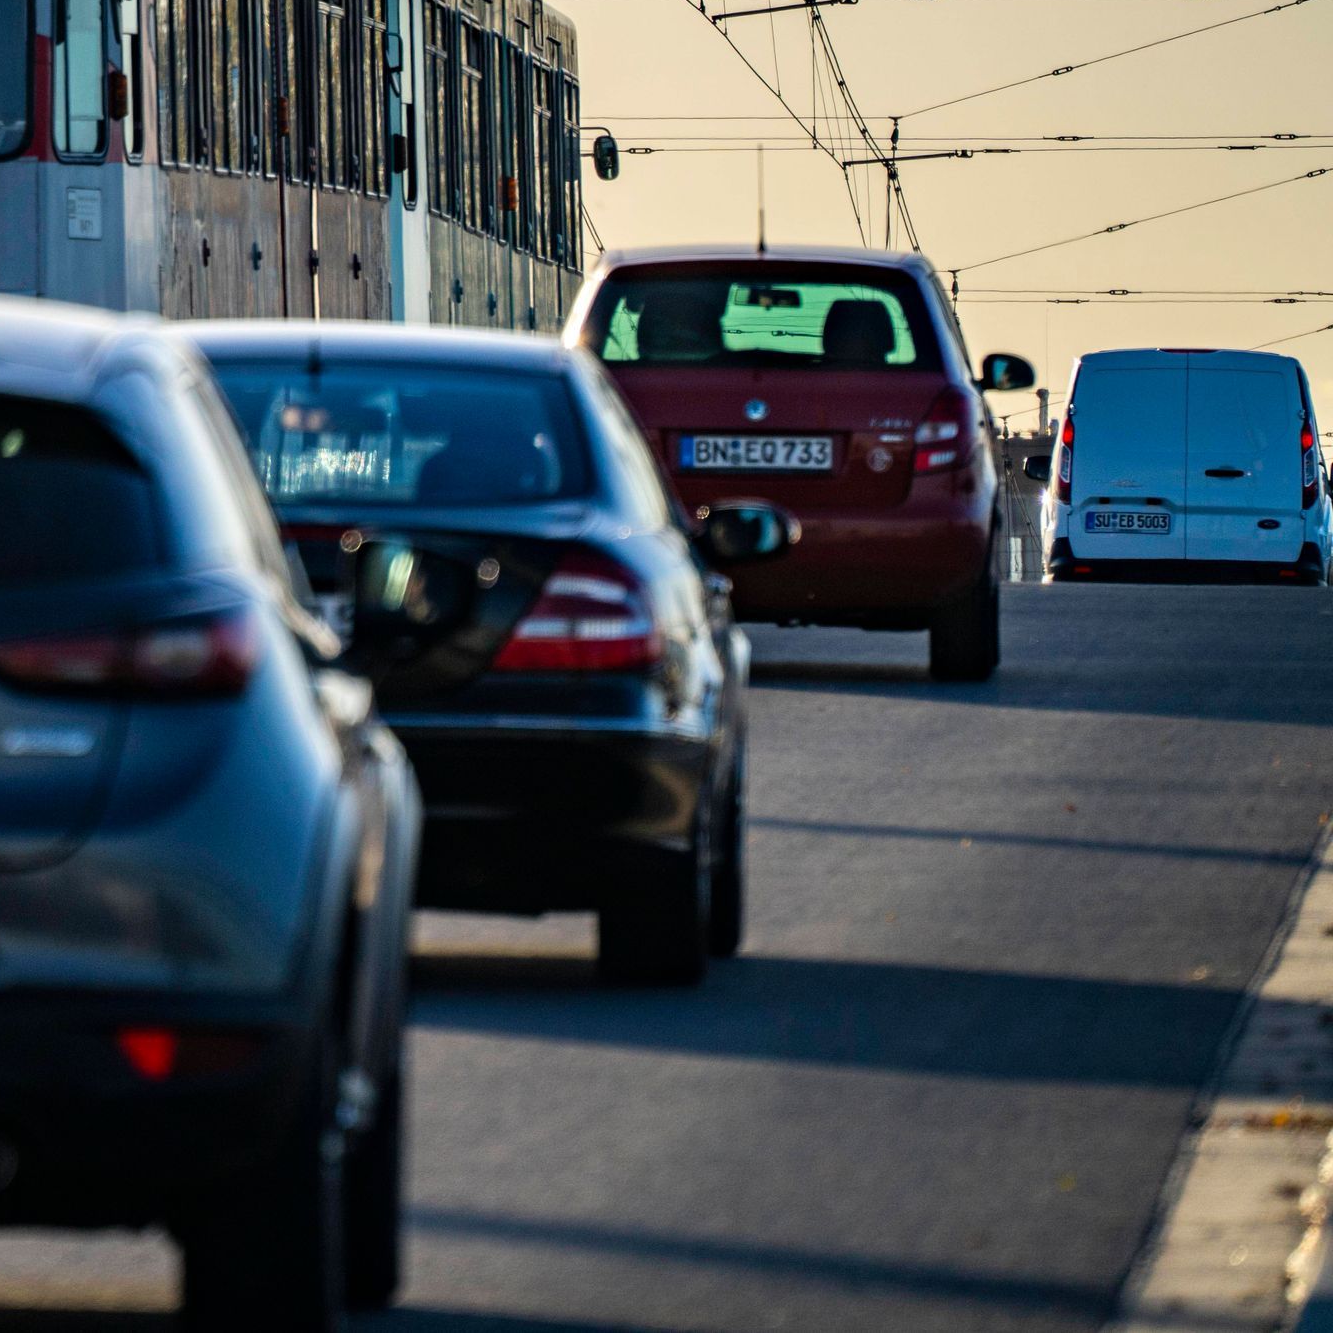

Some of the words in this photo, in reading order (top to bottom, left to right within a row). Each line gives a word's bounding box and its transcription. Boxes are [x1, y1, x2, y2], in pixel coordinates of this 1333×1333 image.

[695, 440, 728, 464] BN
[745, 440, 776, 464] EQ
[783, 440, 830, 465] 733
[1095, 514, 1110, 528] SU
[1119, 514, 1134, 528] EB
[1137, 514, 1168, 528] 5003
